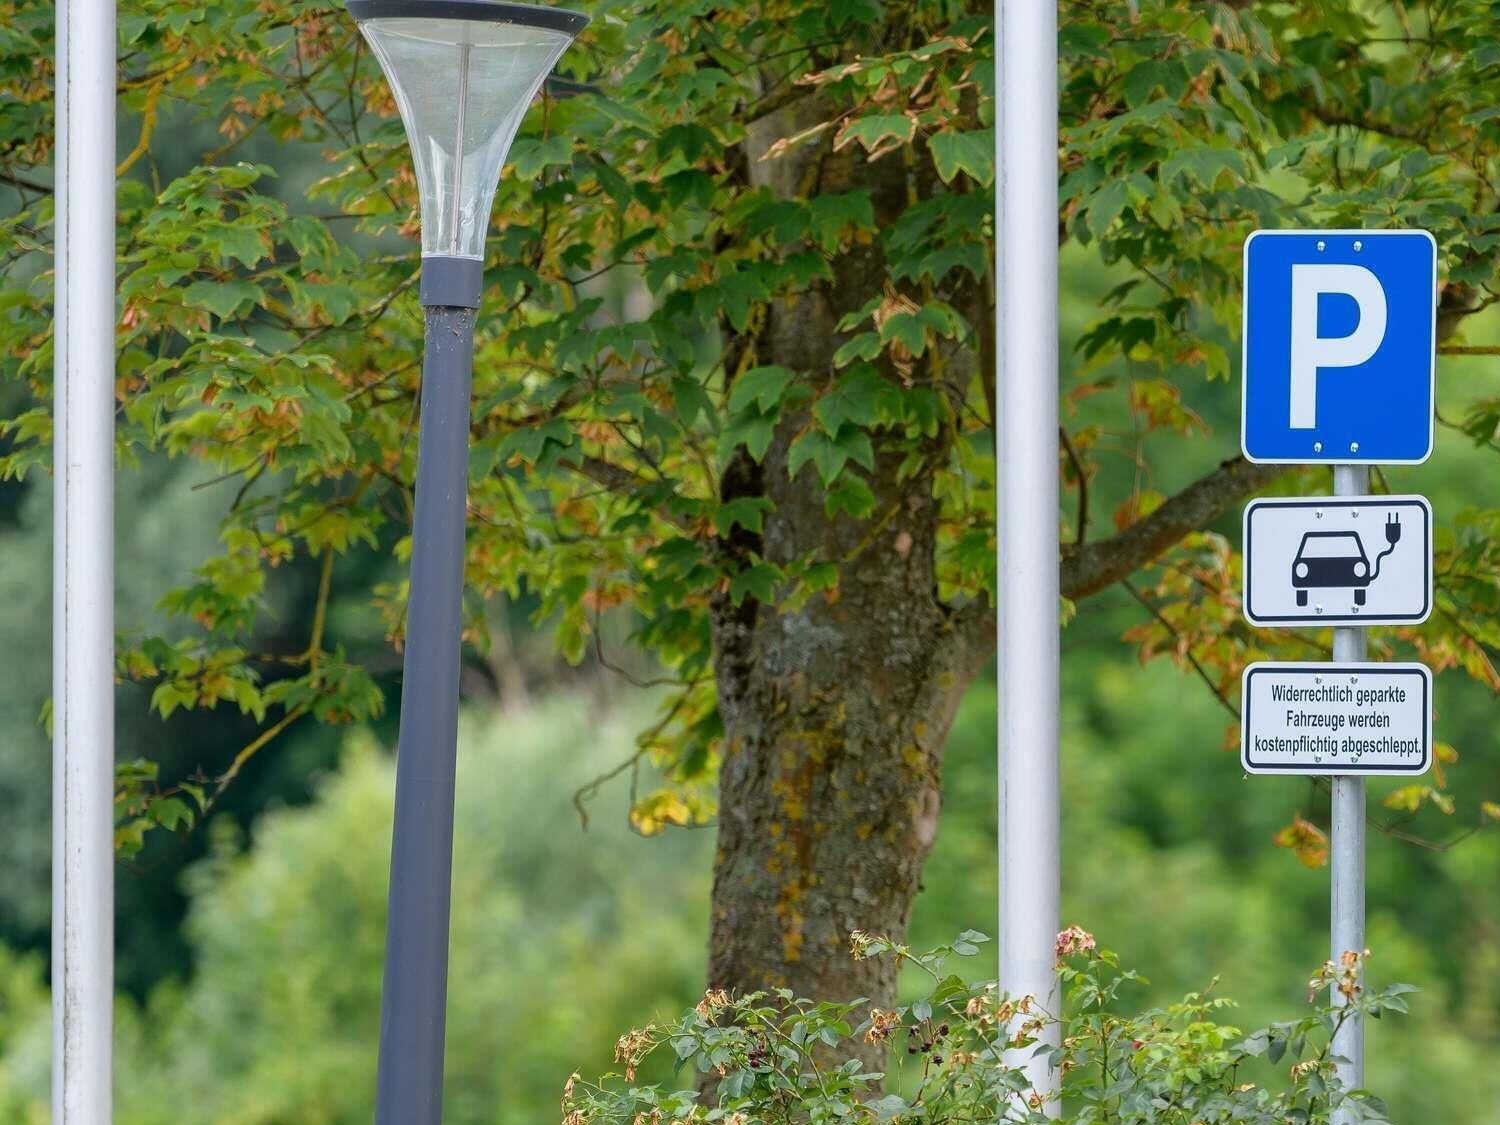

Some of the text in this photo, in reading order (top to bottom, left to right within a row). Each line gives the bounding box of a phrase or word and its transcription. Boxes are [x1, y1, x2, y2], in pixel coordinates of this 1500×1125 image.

[1289, 263, 1388, 429] P
[1271, 684, 1406, 706] Widerrechtlich geparkte
[1286, 710, 1390, 731] Fahrzeuge werden
[1255, 735, 1422, 758] kostenpflichtig abgeschleppt.
